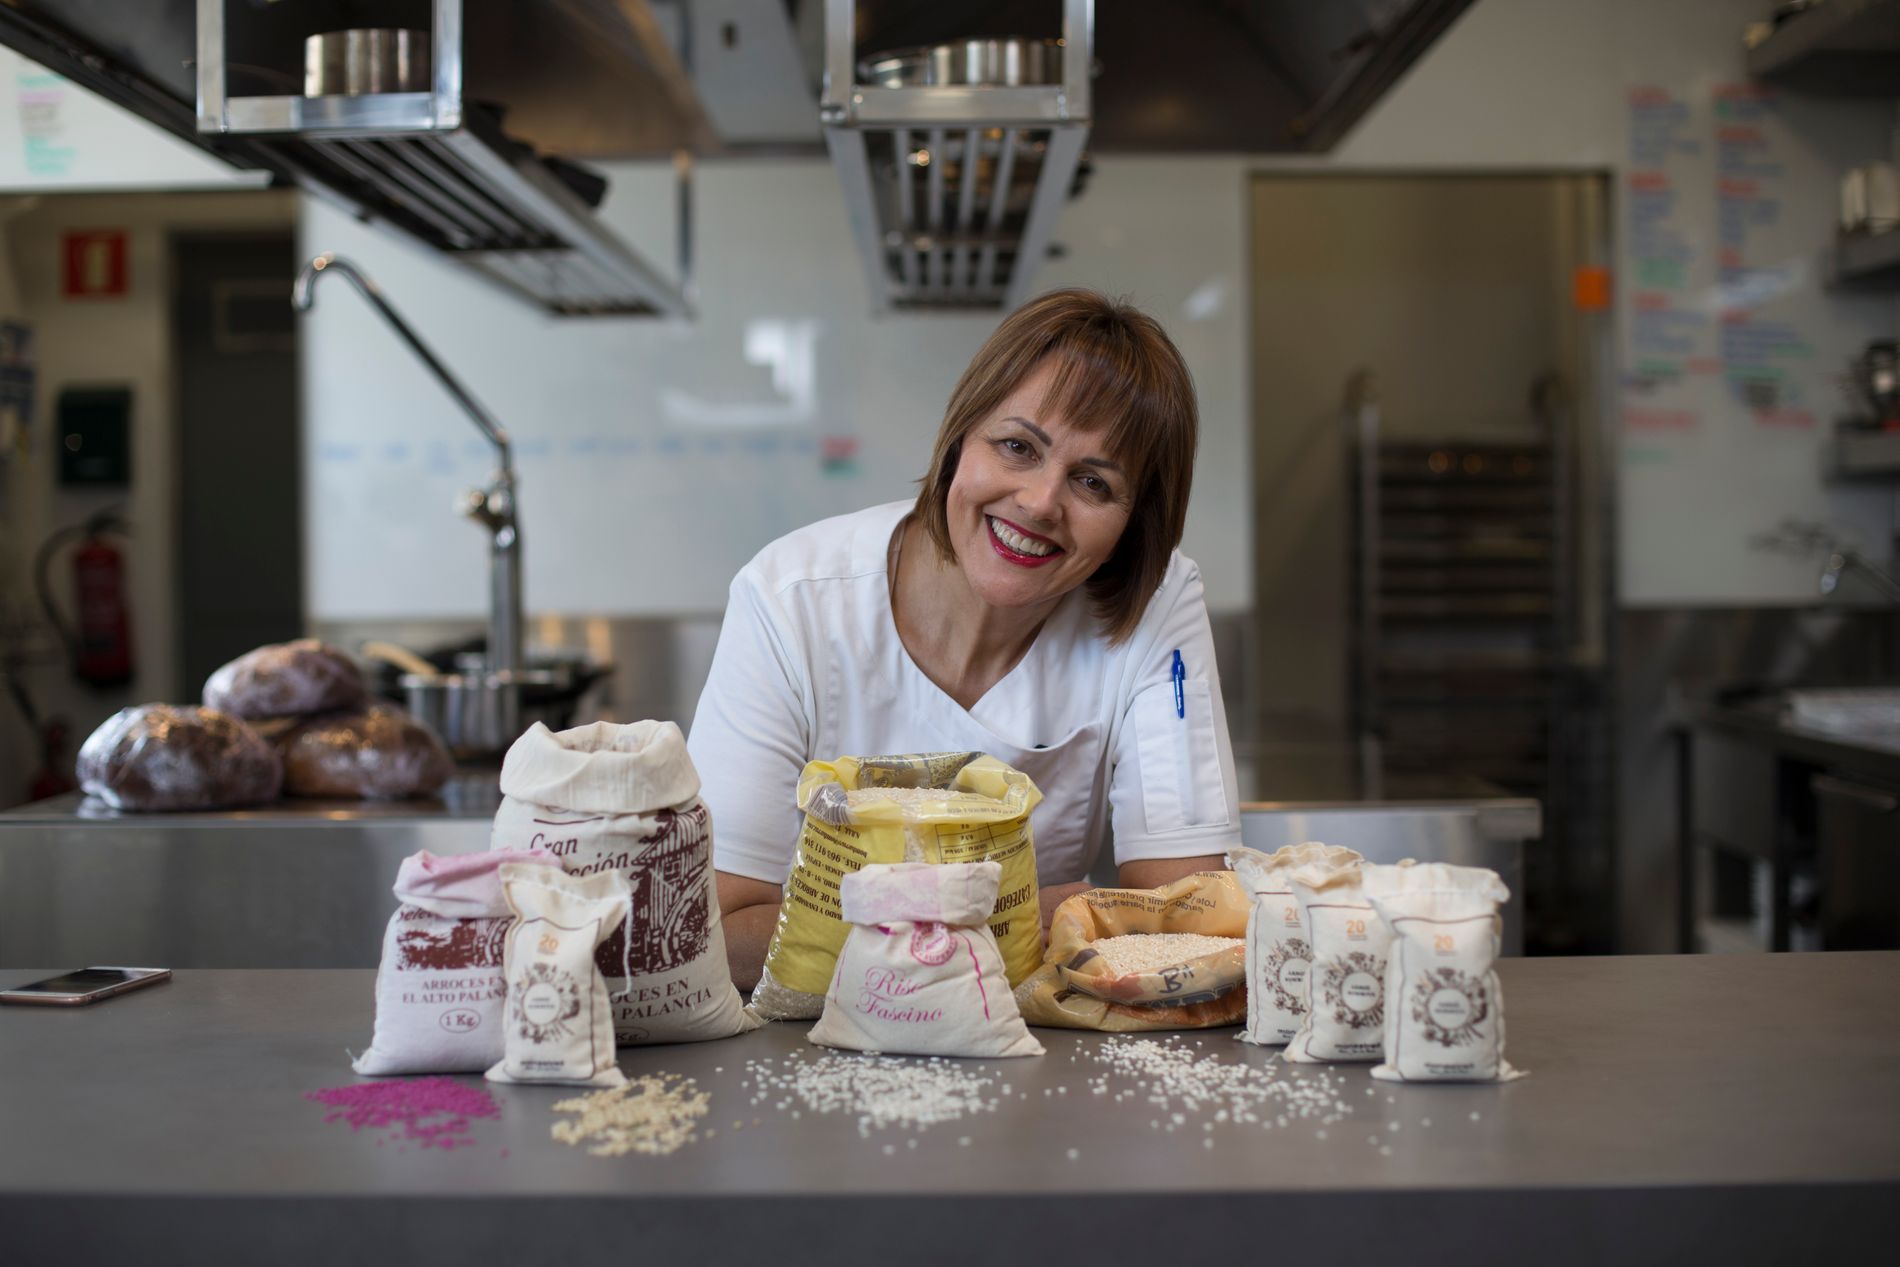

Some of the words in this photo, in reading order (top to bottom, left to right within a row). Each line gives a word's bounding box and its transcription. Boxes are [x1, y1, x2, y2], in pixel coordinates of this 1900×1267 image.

[1345, 919, 1366, 934] 20
[540, 933, 558, 951] 20
[1434, 934, 1453, 950] 20
[422, 977, 485, 991] ARROCES
[665, 978, 690, 997] EN
[402, 993, 417, 1003] EL
[421, 991, 457, 1004] ALTO
[620, 985, 713, 1020] PALANCIA
[856, 986, 943, 1023] Fascino
[445, 1015, 453, 1027] 1
